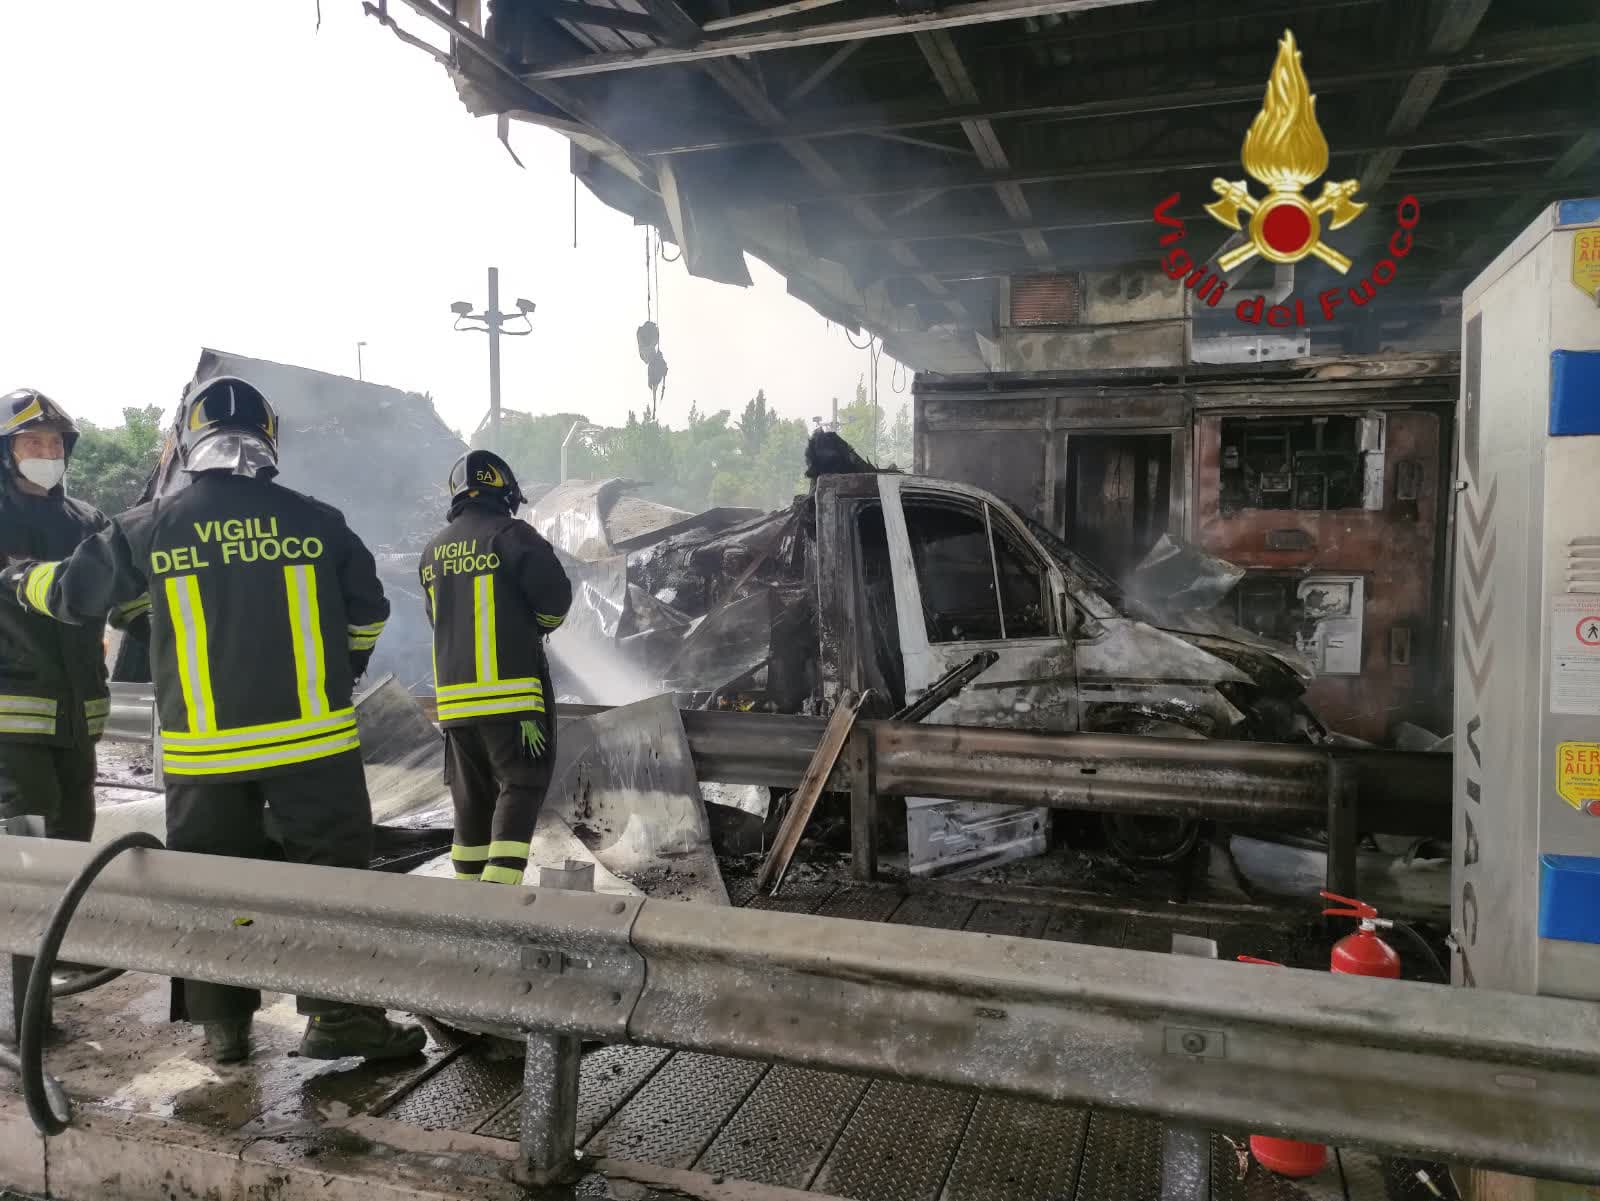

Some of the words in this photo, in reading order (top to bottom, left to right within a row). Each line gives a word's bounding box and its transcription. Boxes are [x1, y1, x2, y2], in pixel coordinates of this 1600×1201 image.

[476, 470, 493, 482] 5A
[193, 516, 279, 544] VIGILI
[151, 545, 209, 574] DEL
[222, 536, 324, 564] FUOCO
[434, 538, 477, 561] VIGILI
[443, 553, 500, 576] FUOCO
